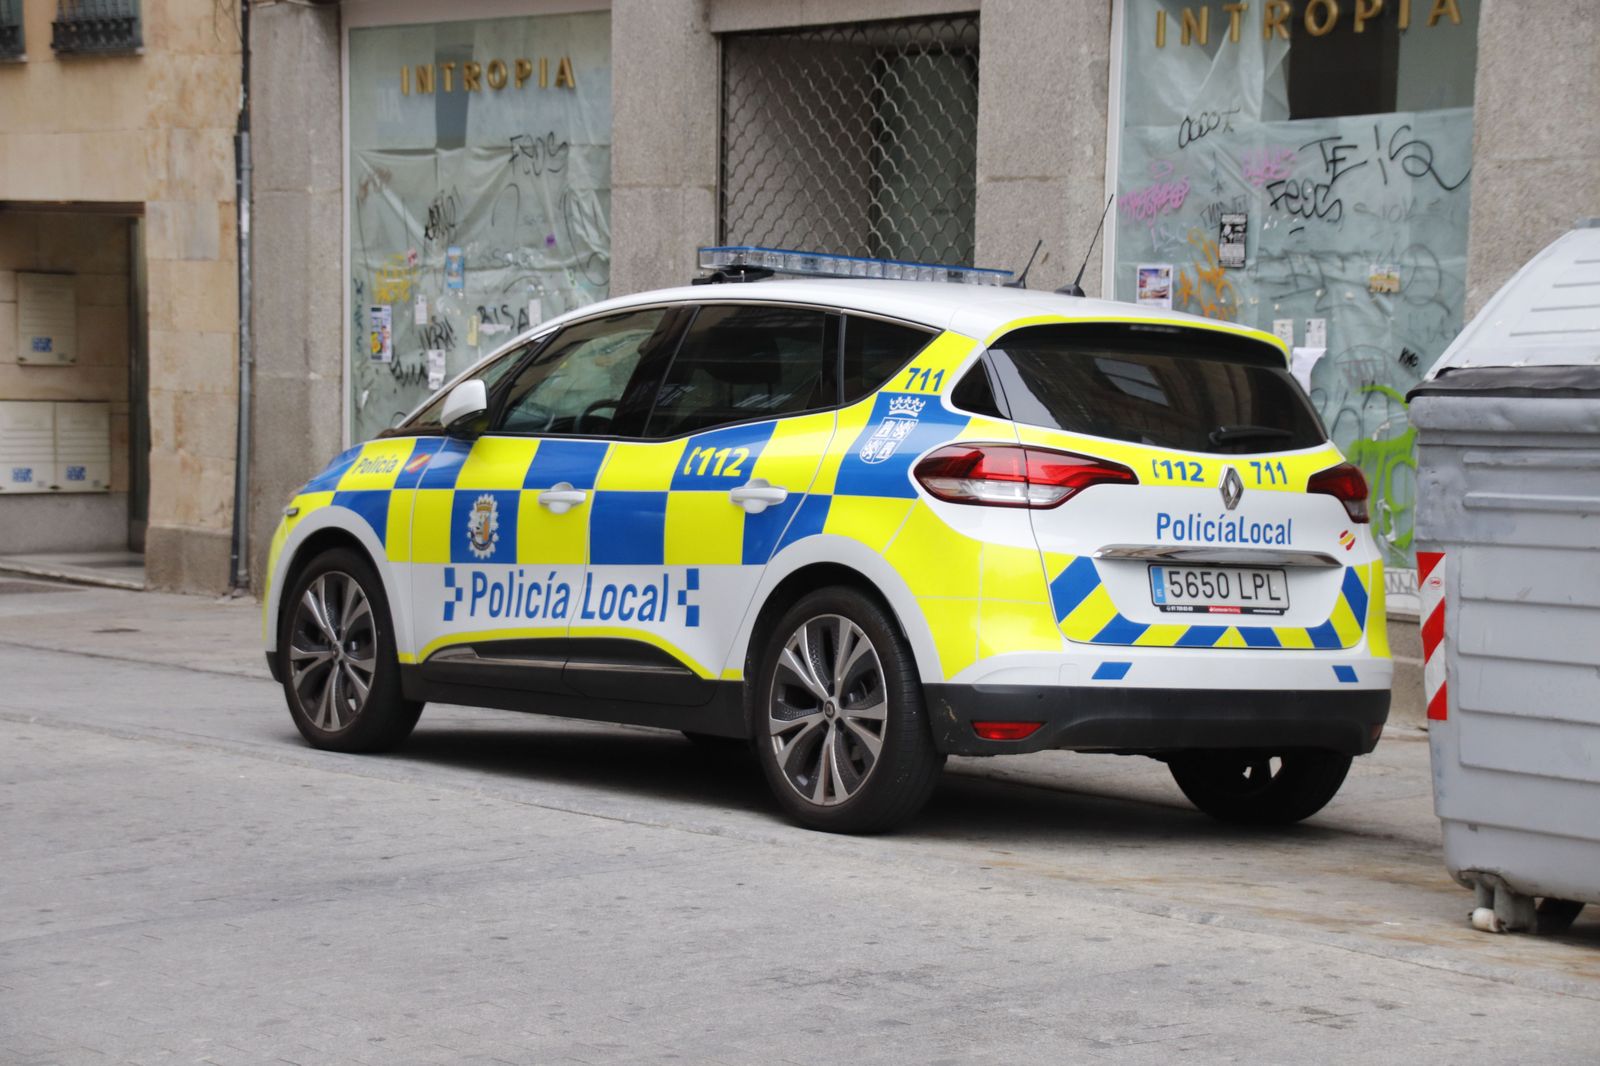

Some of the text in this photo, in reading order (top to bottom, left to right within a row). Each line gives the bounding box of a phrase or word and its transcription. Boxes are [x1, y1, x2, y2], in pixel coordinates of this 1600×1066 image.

[1155, 0, 1462, 48] INTROPIA
[401, 56, 576, 96] INTROPIA
[905, 367, 945, 393] 711
[352, 454, 398, 475] Policía
[696, 446, 750, 477] 112
[1160, 459, 1204, 482] 112
[1250, 461, 1287, 485] 711
[470, 569, 669, 622] Policía Local
[1168, 570, 1282, 601] 5650 LPL
